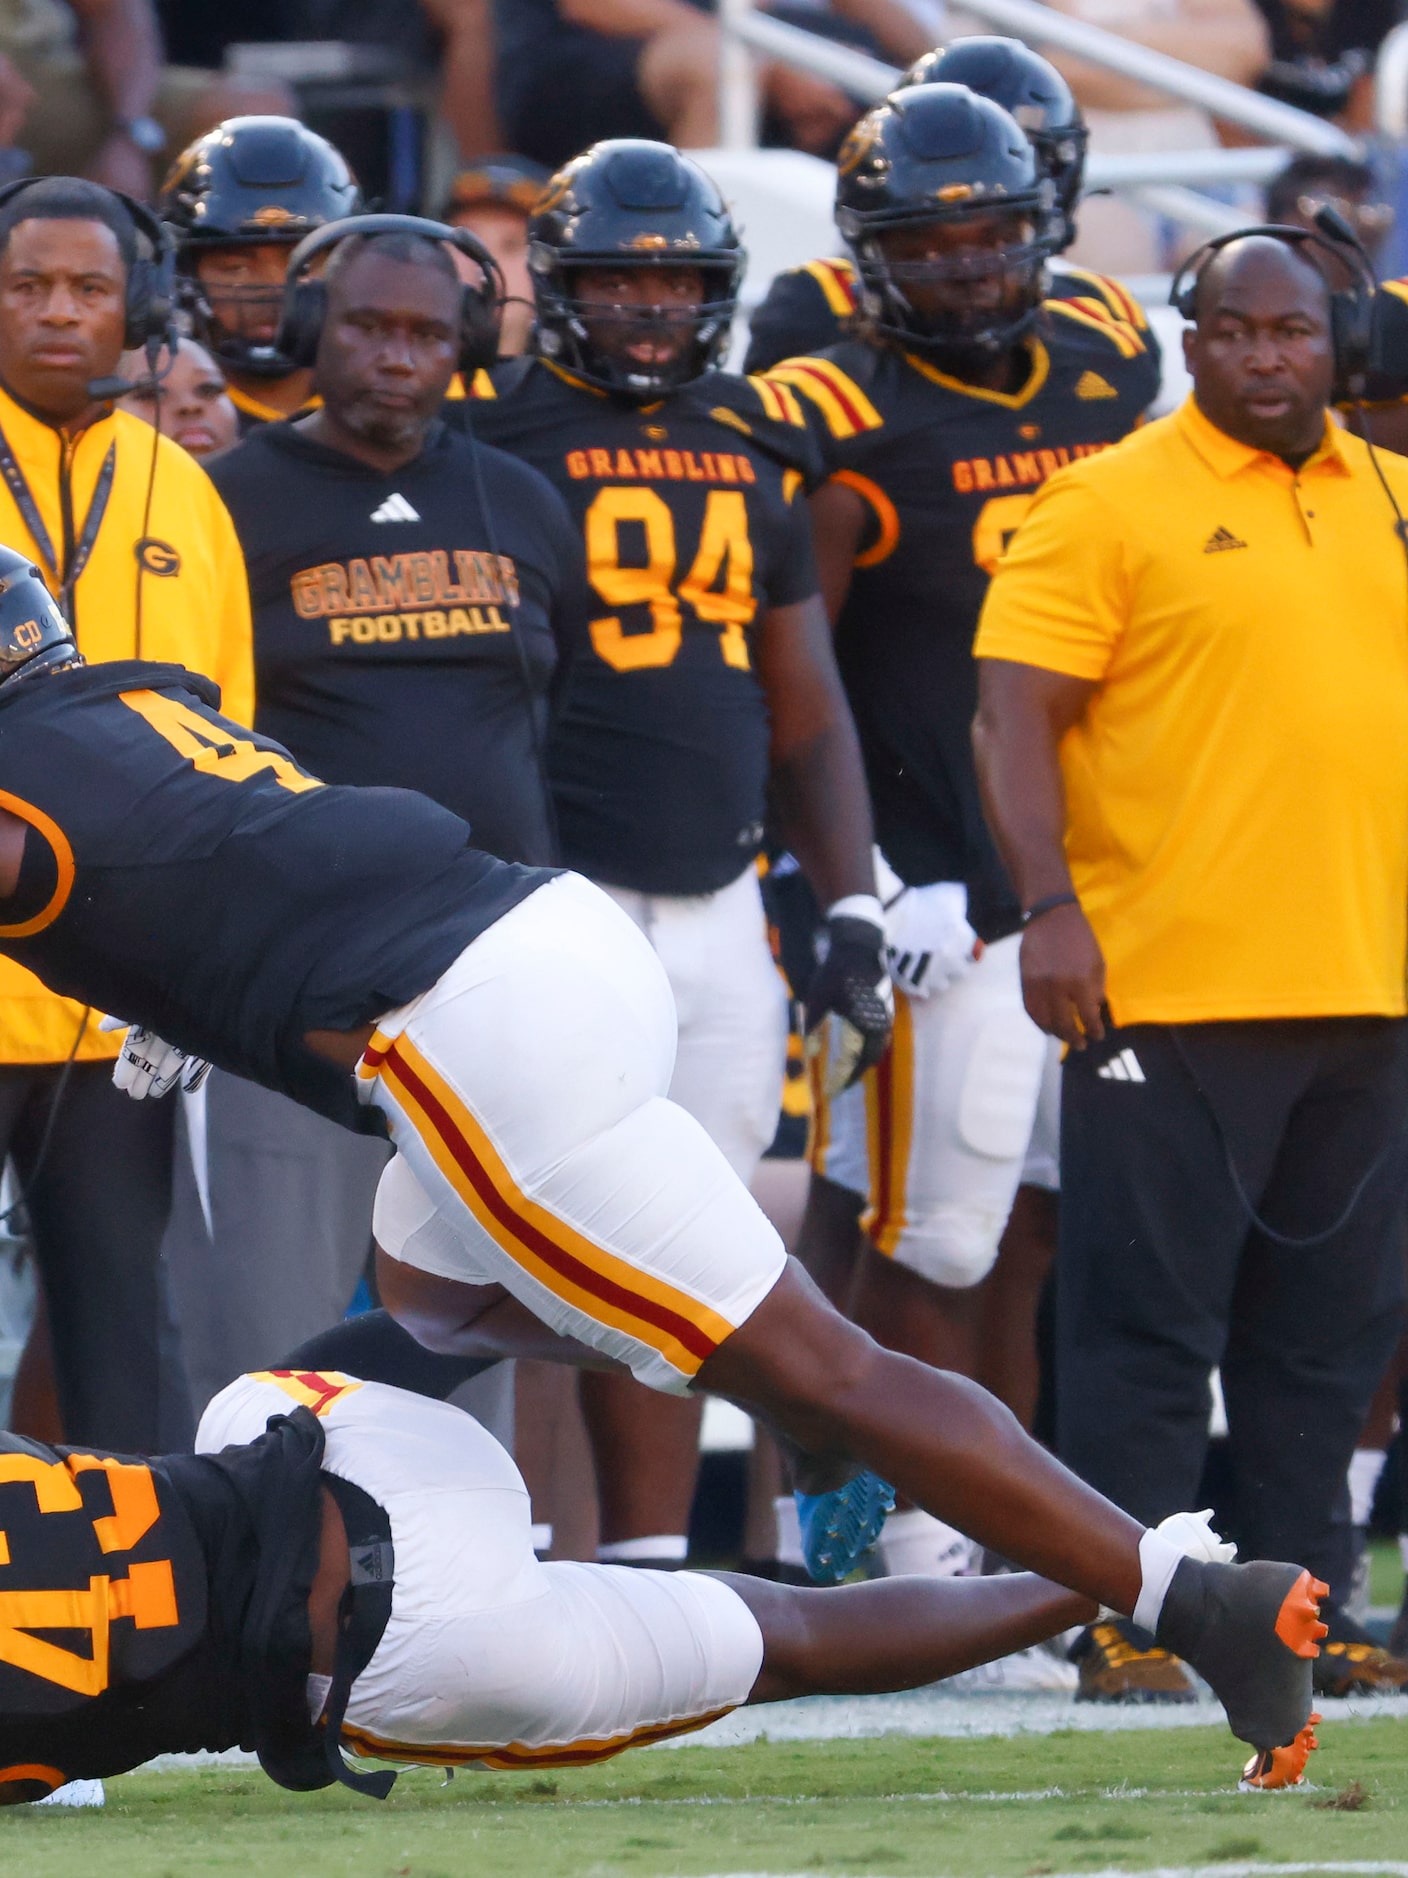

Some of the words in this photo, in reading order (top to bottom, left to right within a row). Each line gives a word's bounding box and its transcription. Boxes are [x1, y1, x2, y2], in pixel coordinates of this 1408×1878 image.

[565, 448, 756, 483] GRAMBLING
[952, 442, 1114, 493] GRAMB
[134, 536, 180, 578] G
[585, 486, 757, 672] 94
[14, 619, 42, 648] CD
[329, 606, 511, 646] FOOTBALL
[118, 687, 327, 794] 4
